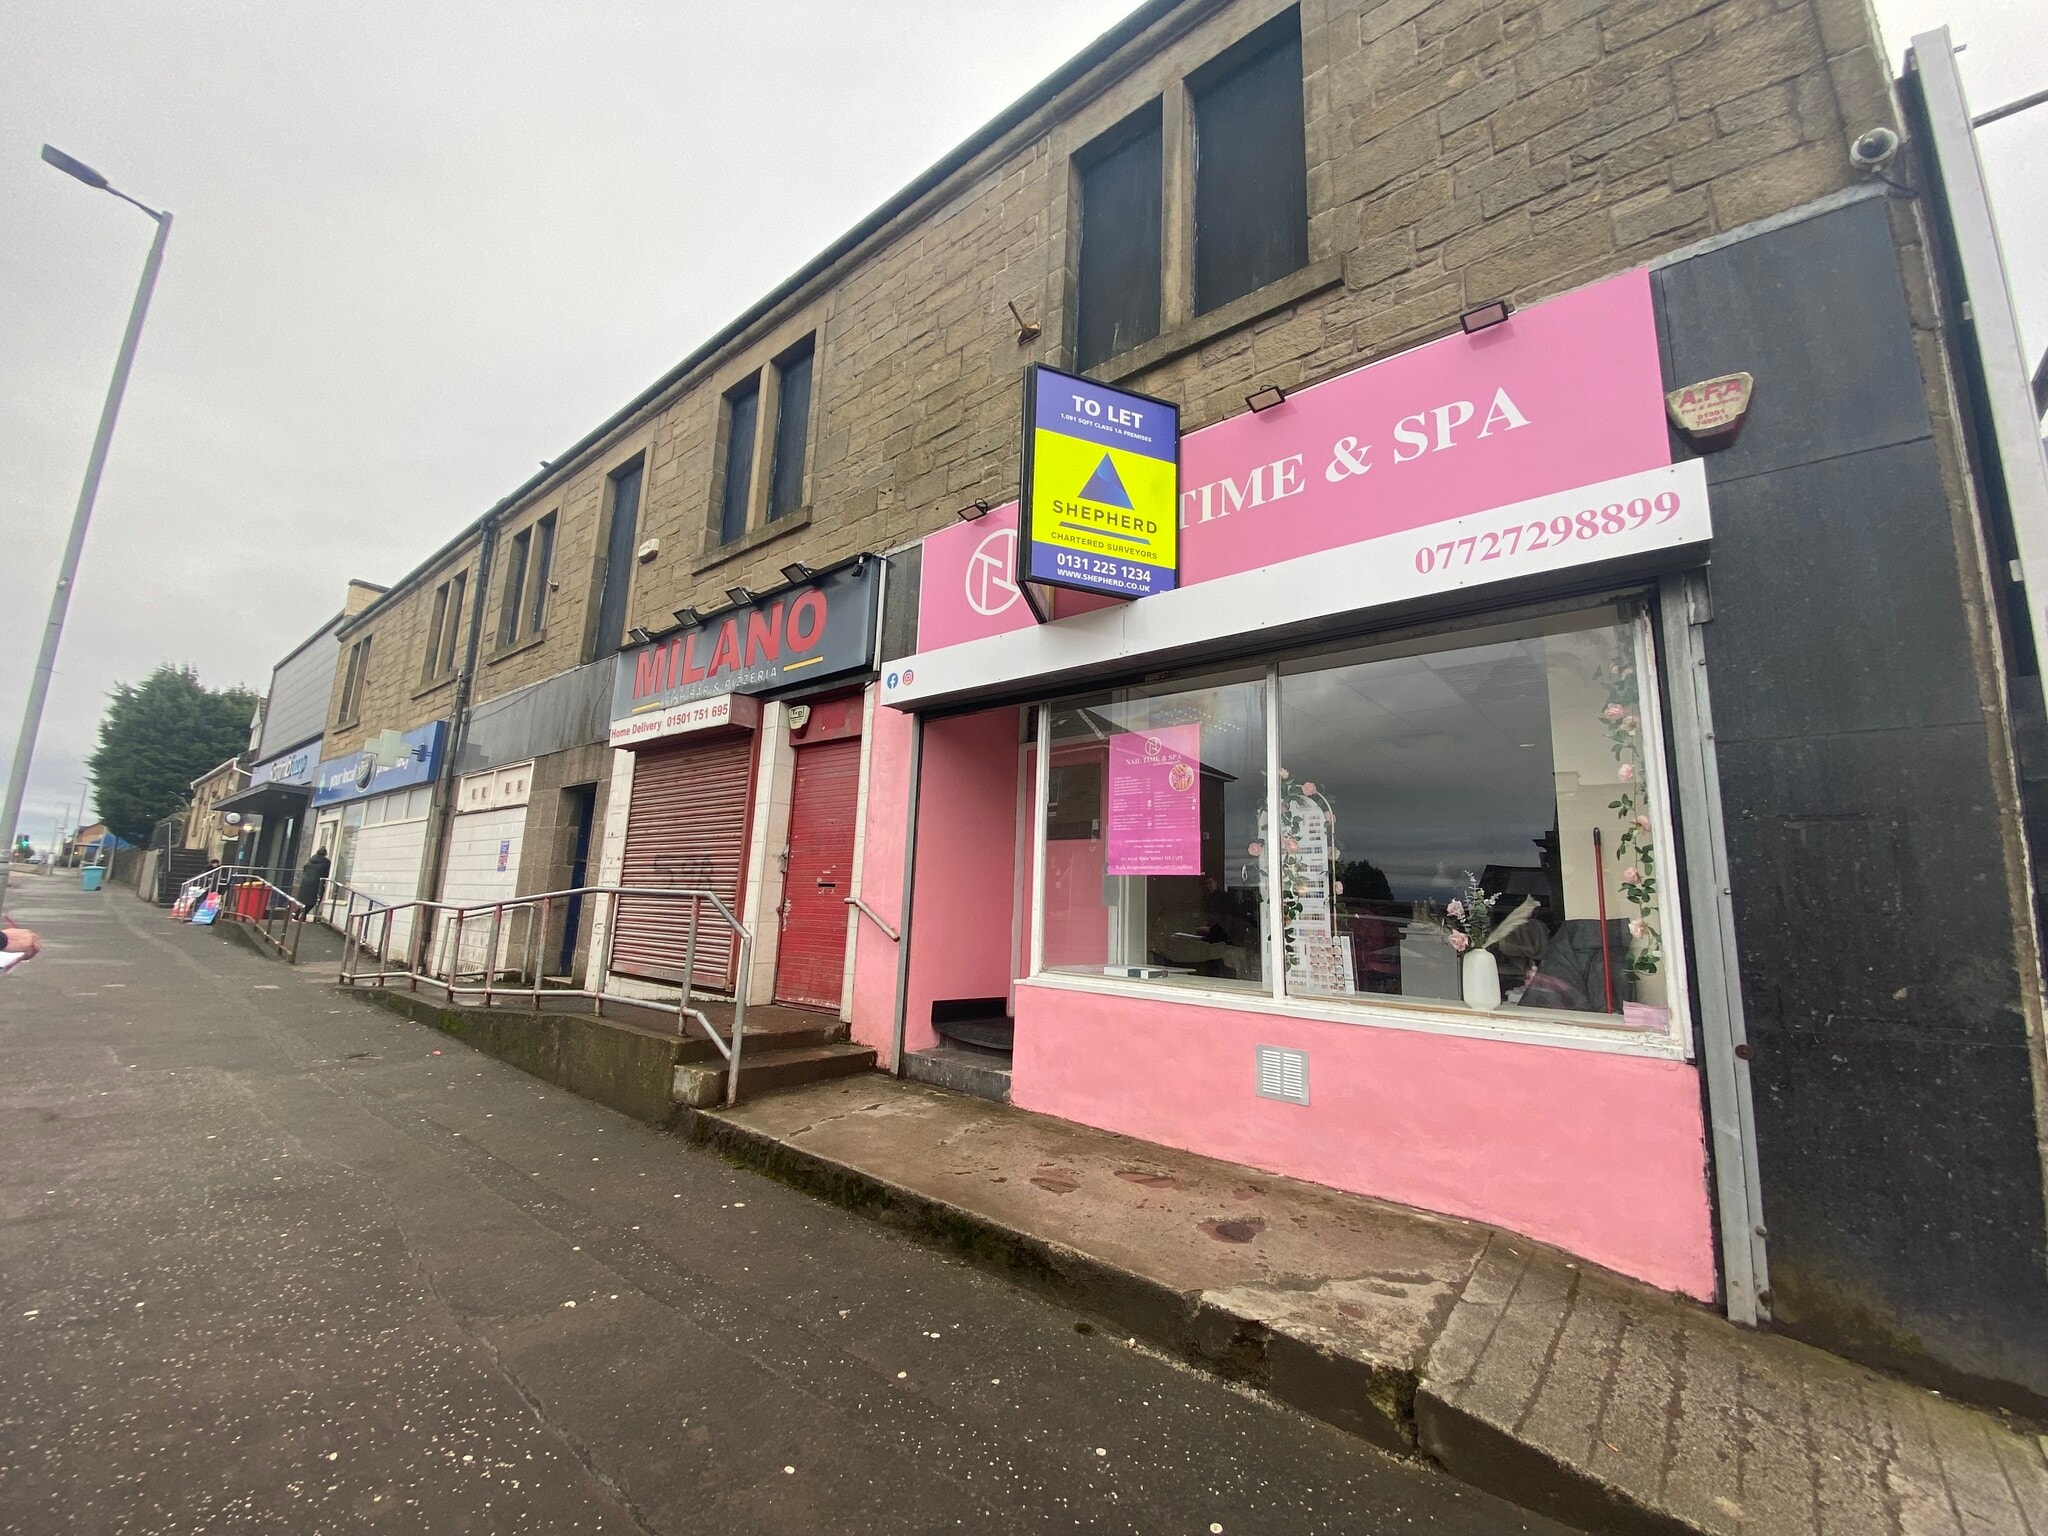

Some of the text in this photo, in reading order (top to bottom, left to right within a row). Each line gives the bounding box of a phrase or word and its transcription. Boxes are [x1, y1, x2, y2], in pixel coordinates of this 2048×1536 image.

[1072, 394, 1144, 429] TO LET
[1078, 418, 1094, 427] SQFT
[1094, 422, 1113, 432] CLASS
[1123, 430, 1152, 442] PREMISES
[1179, 386, 1532, 530] TIME & SPA
[1052, 499, 1158, 534] SHEPHERD
[1415, 491, 1681, 574] 07727298899
[1051, 531, 1158, 560] CHARTERED SURVEYORS
[1056, 552, 1151, 583] 0131 225 1234
[1057, 568, 1151, 593] WWW.SHEPHERD.CO.UK
[632, 587, 828, 700] MILANO
[690, 685, 709, 698] BAR
[725, 667, 777, 688] PIZZERIA
[611, 704, 728, 739] Home Delivery 01501 751 695
[1168, 753, 1182, 761] SPA
